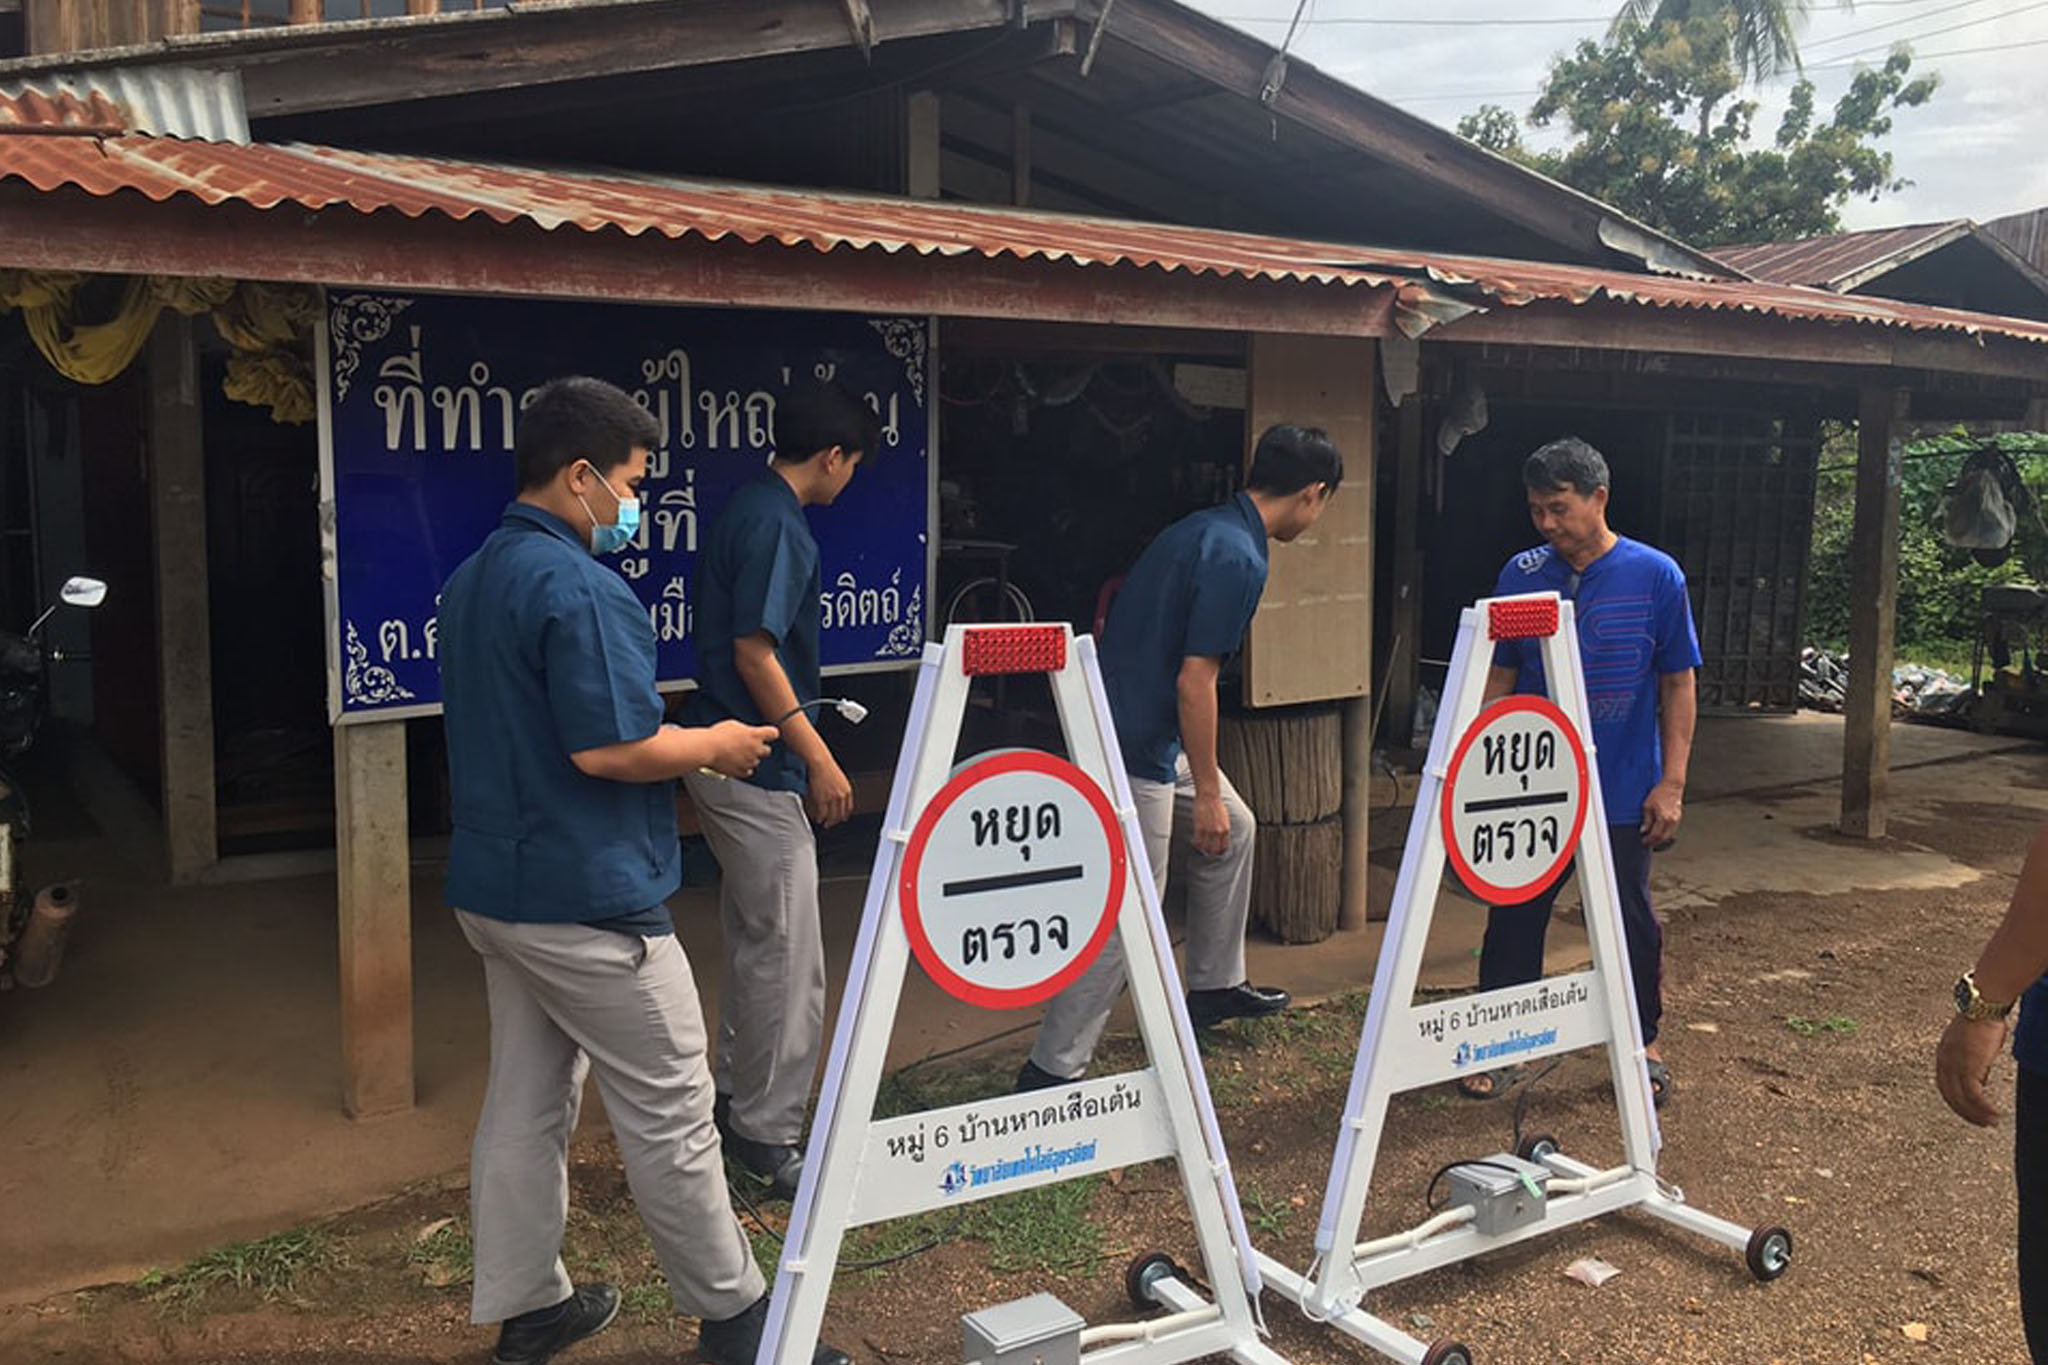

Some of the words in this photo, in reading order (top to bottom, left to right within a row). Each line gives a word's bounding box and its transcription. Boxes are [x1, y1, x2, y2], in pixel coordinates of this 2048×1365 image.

[820, 566, 901, 629] รดิตถ์
[1483, 729, 1556, 792] หยุด
[970, 801, 1062, 863] หยุด
[1472, 815, 1559, 866] ตรวจ
[961, 914, 1069, 966] ตรวจ
[1418, 1009, 1445, 1042] หมู่
[1449, 1011, 1461, 1031] 6
[886, 1123, 926, 1163] หมู่
[934, 1125, 949, 1149] 6
